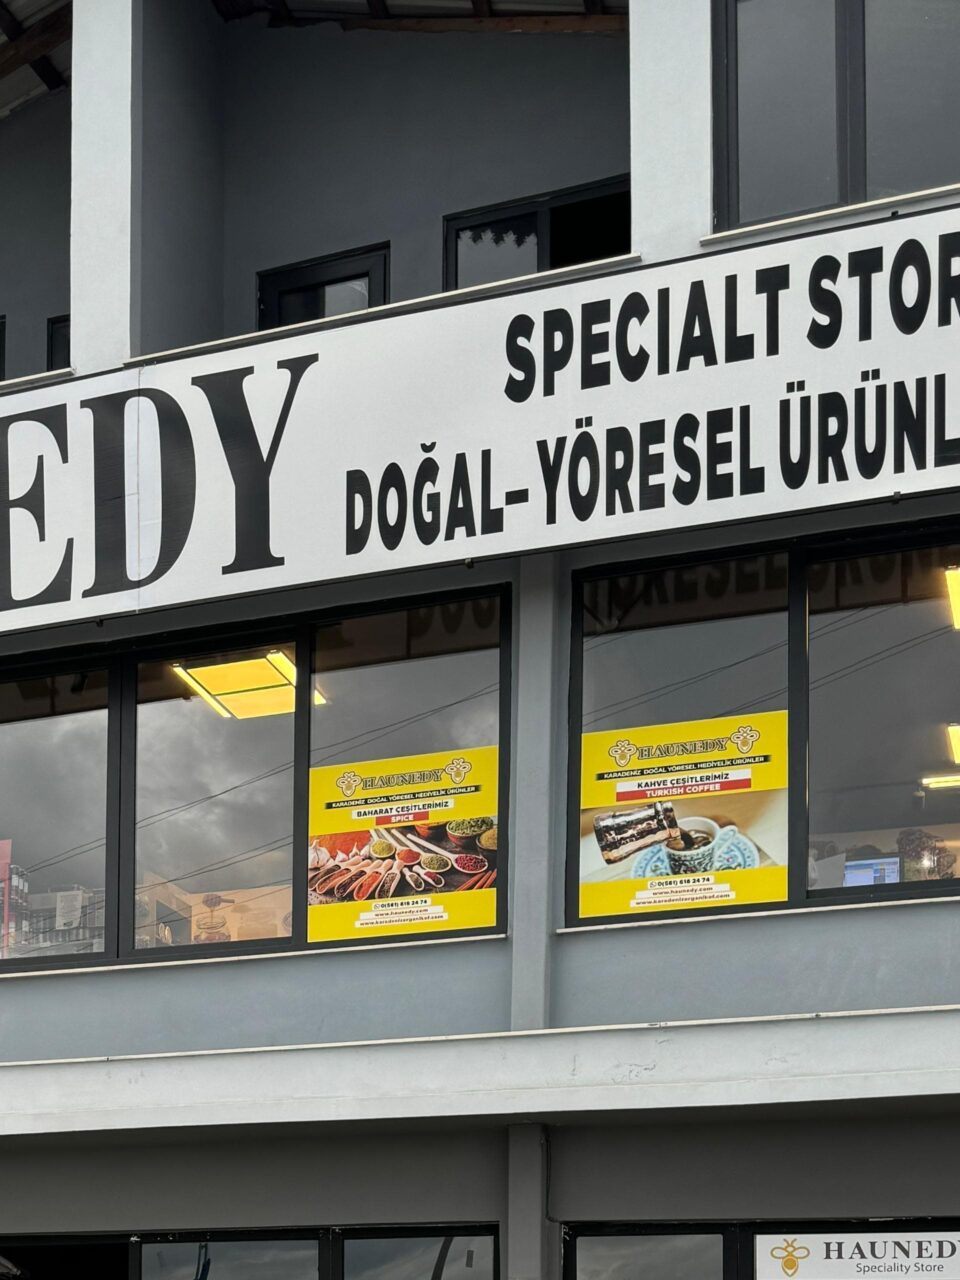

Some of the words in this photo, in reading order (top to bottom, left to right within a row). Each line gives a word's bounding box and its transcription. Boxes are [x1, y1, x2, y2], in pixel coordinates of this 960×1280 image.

[504, 264, 790, 403] SPECIALT
[807, 231, 960, 350] STOR
[778, 370, 960, 491] ÜRÜNL
[638, 737, 729, 760] HAUNEDY
[362, 769, 444, 790] HAUNEDY
[637, 778, 669, 788] KAHVE
[670, 772, 730, 786] ÇEŞİTLERİMİZ
[646, 786, 684, 798] TURKISH
[686, 783, 721, 793] COFFEE
[357, 808, 393, 817] BAHARAT
[395, 801, 450, 815] ÇEŞİTLERİMİZ
[391, 814, 414, 823] SPICE
[823, 1240, 960, 1259] HAUNED
[856, 1263, 911, 1275] Speciality
[914, 1262, 944, 1272] Store
